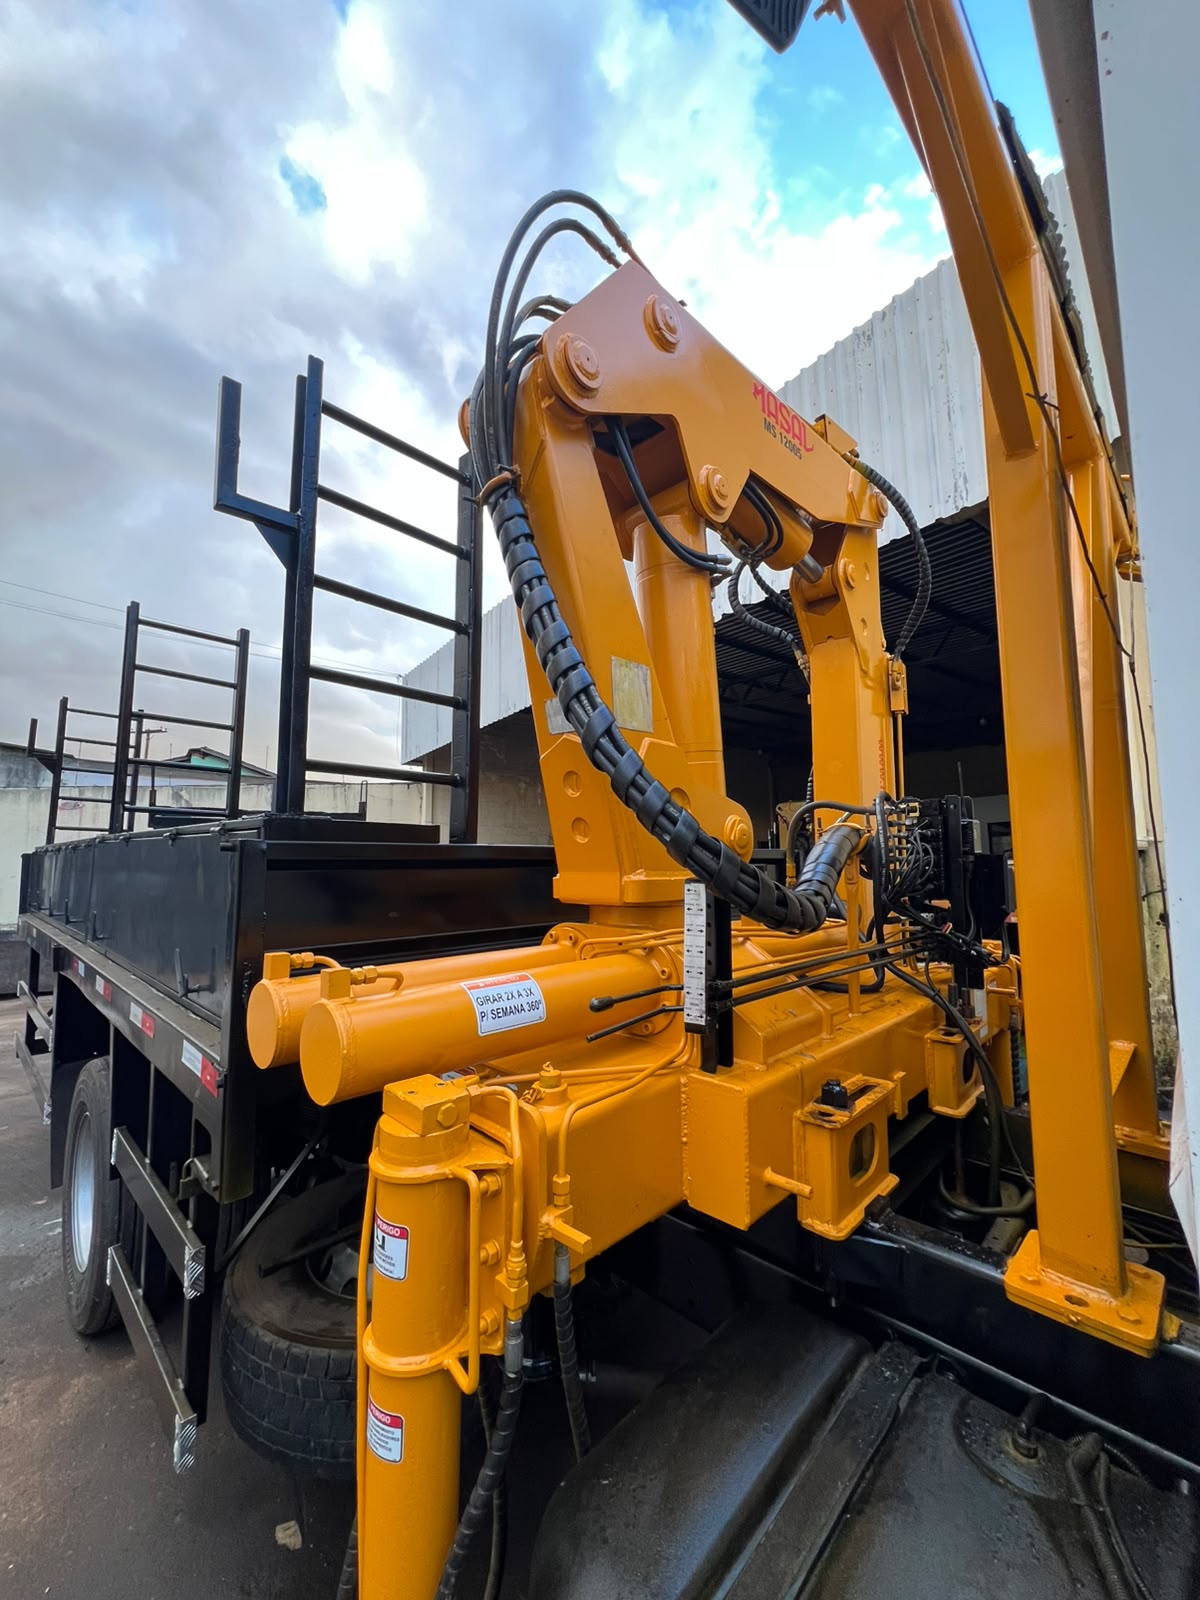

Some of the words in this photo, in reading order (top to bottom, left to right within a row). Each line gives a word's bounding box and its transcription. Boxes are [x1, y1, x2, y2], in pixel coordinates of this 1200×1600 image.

[752, 382, 814, 452] MASAL
[763, 417, 777, 438] MS
[476, 993, 504, 1007] GIRAR
[505, 991, 516, 1001] 2X
[517, 990, 524, 999] A
[523, 987, 535, 998] 3X
[480, 1010, 489, 1022] P/
[491, 1004, 526, 1020] SEMANA
[377, 1219, 401, 1237] PERIGO
